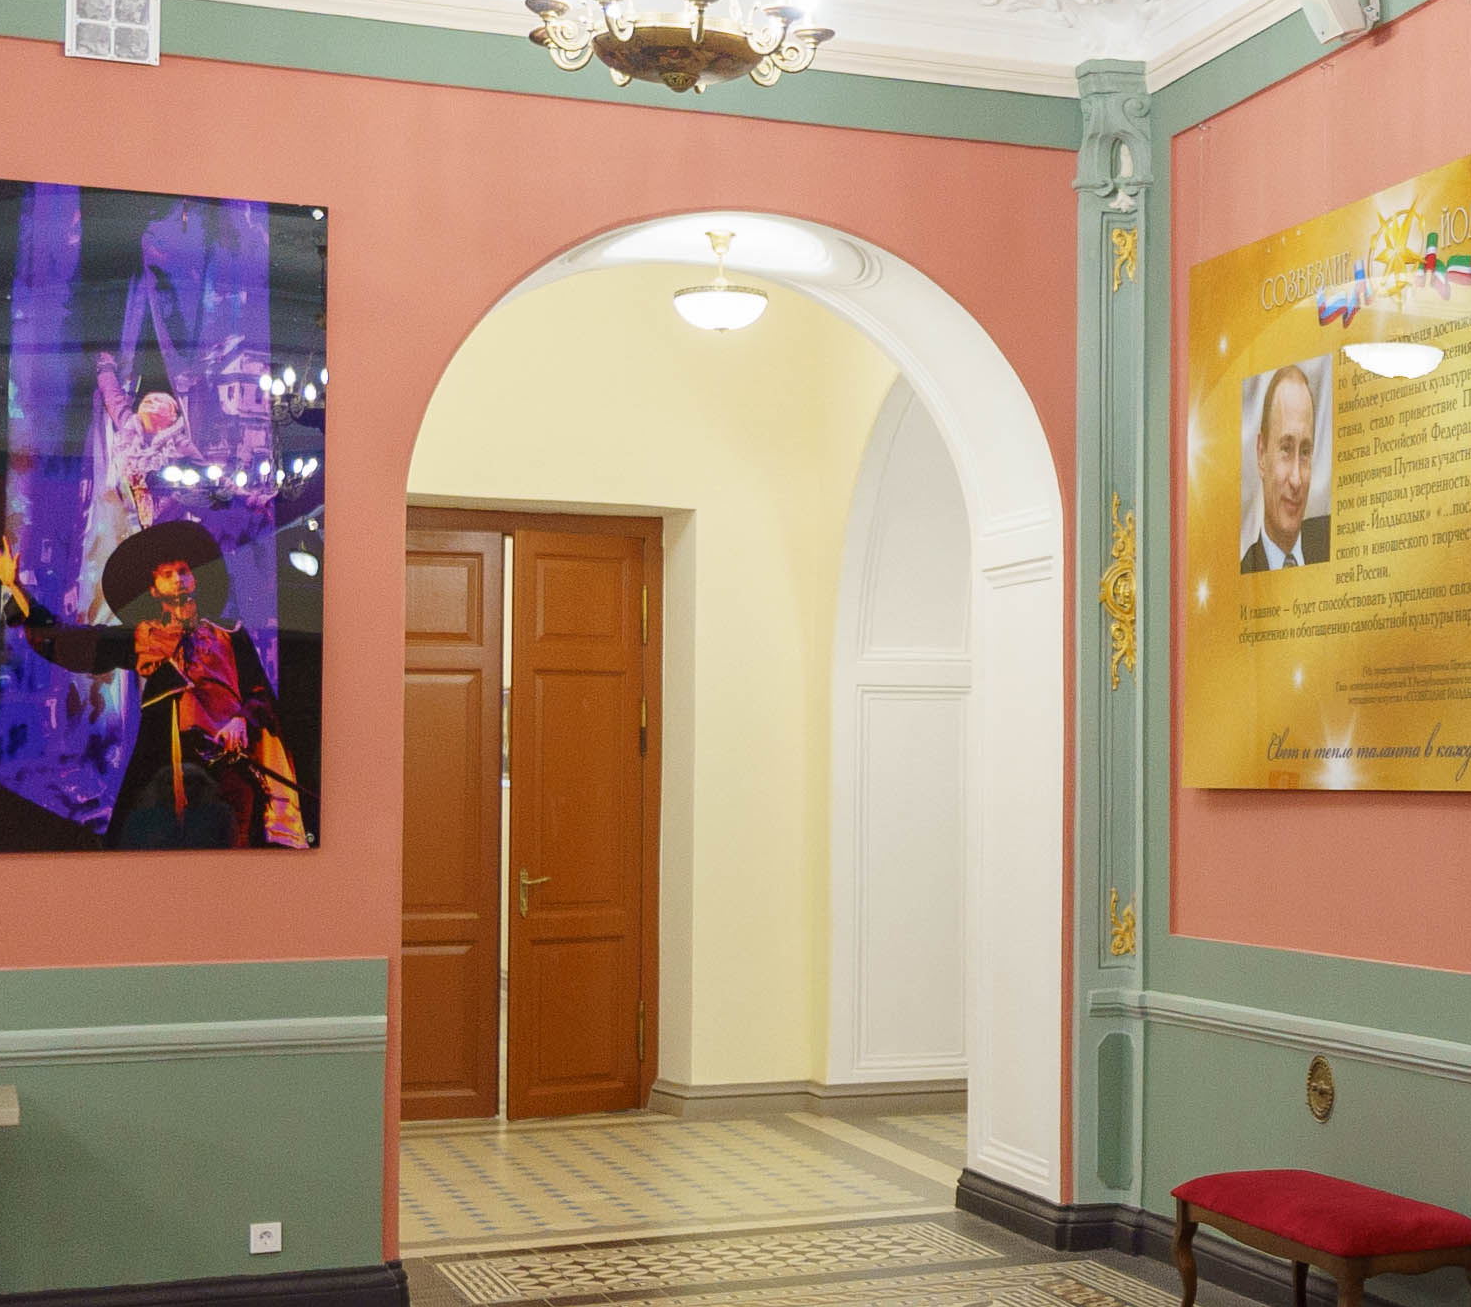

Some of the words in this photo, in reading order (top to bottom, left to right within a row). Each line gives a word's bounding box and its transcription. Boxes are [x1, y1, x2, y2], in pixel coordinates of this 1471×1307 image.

[1260, 251, 1353, 311] СОЗВЕЗДИЕ
[1338, 393, 1379, 414] наиболее
[1380, 378, 1428, 407] успешных
[1337, 422, 1366, 439] стана,
[1369, 414, 1395, 430] стало
[1398, 397, 1458, 427] приветствие
[1337, 445, 1371, 462] ельства
[1373, 427, 1428, 455] Российской
[1337, 464, 1393, 488] димировича
[1393, 456, 1430, 478] Путина
[1336, 500, 1355, 516] ром
[1356, 496, 1368, 508] он
[1369, 488, 1408, 508] выразил
[1336, 545, 1360, 560] ского
[1362, 545, 1369, 557] и
[1371, 534, 1429, 556] юношеского
[1336, 568, 1356, 585] всей
[1356, 563, 1391, 583] России.
[1240, 604, 1249, 621] И
[1249, 605, 1281, 619] главное
[1292, 598, 1316, 618] будет
[1318, 592, 1387, 613] способствовать
[1388, 584, 1446, 608] укреплению
[1350, 613, 1408, 633] самобытной
[1408, 608, 1455, 631] культуры
[1313, 745, 1354, 761] тепло
[1356, 744, 1421, 760] таланта
[1423, 722, 1442, 759] в
